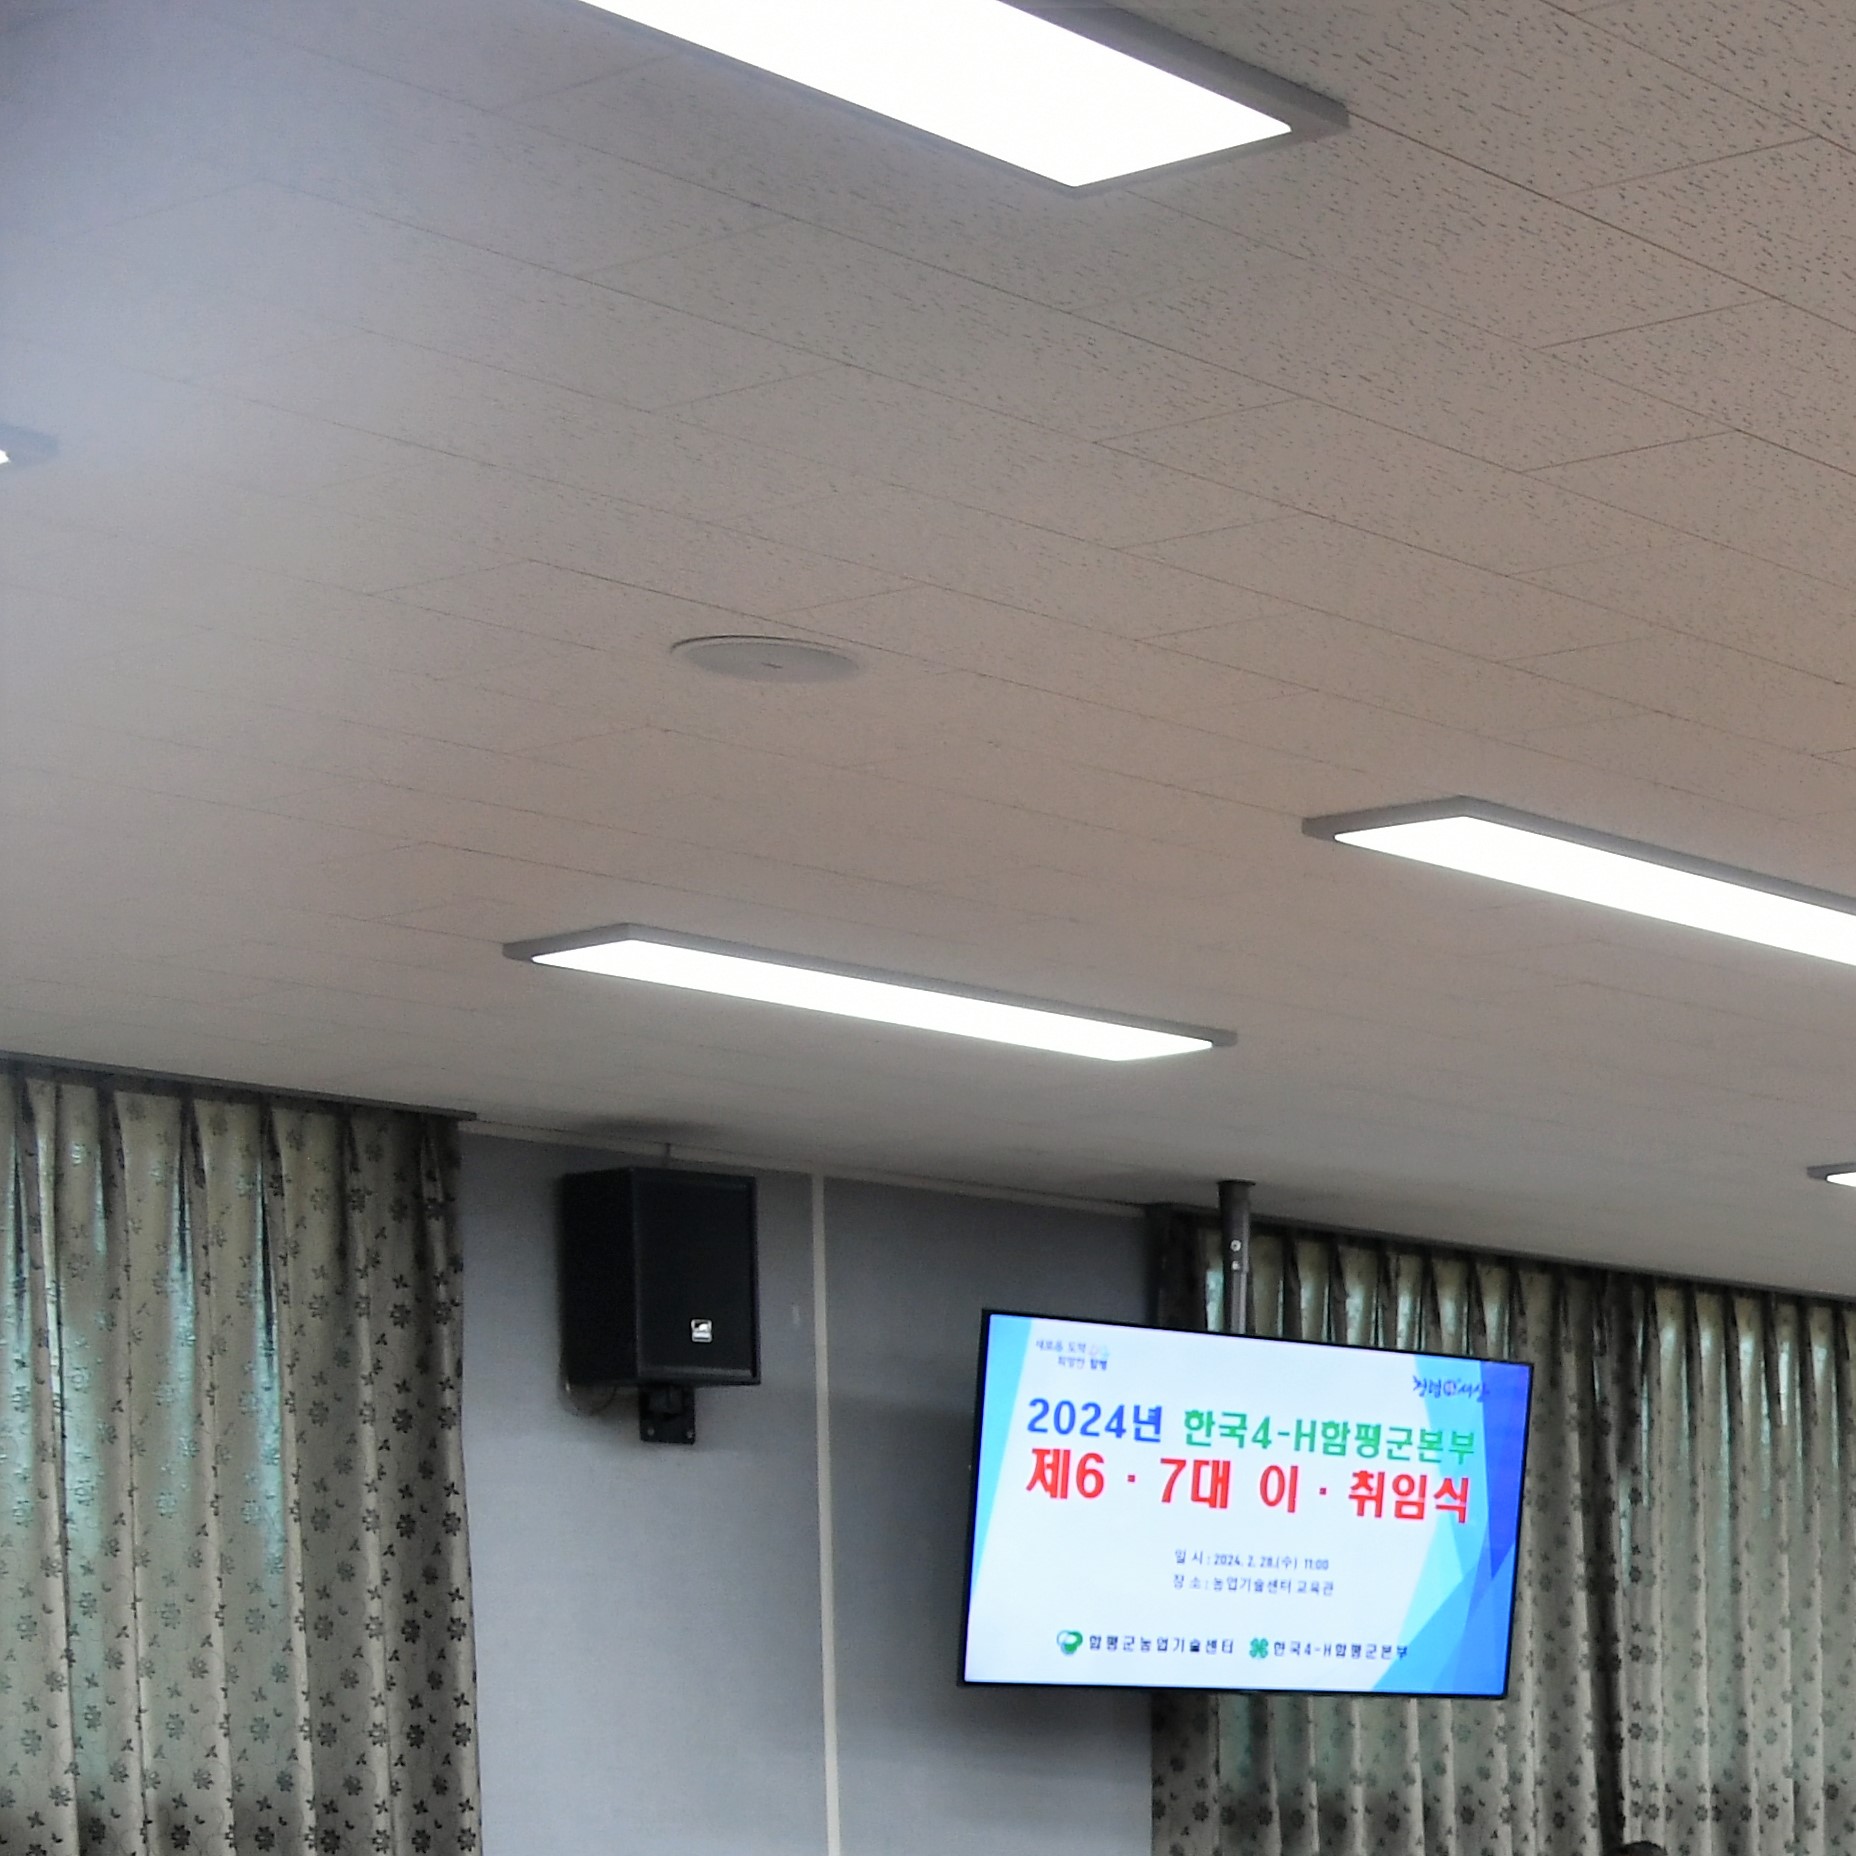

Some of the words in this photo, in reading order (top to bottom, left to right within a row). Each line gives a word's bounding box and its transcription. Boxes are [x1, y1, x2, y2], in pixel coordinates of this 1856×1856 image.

[1027, 1397, 1163, 1444] 2024년
[1182, 1408, 1476, 1466] 한국4-H함평군본부
[1159, 1457, 1230, 1509] 7대
[1259, 1464, 1299, 1514] 이
[1347, 1470, 1471, 1524] 취임식
[1213, 1577, 1292, 1594] 농업기술센터
[1088, 1635, 1235, 1654] 함평군농업기술센터
[1273, 1641, 1408, 1660] 한국4-H함평군본부
